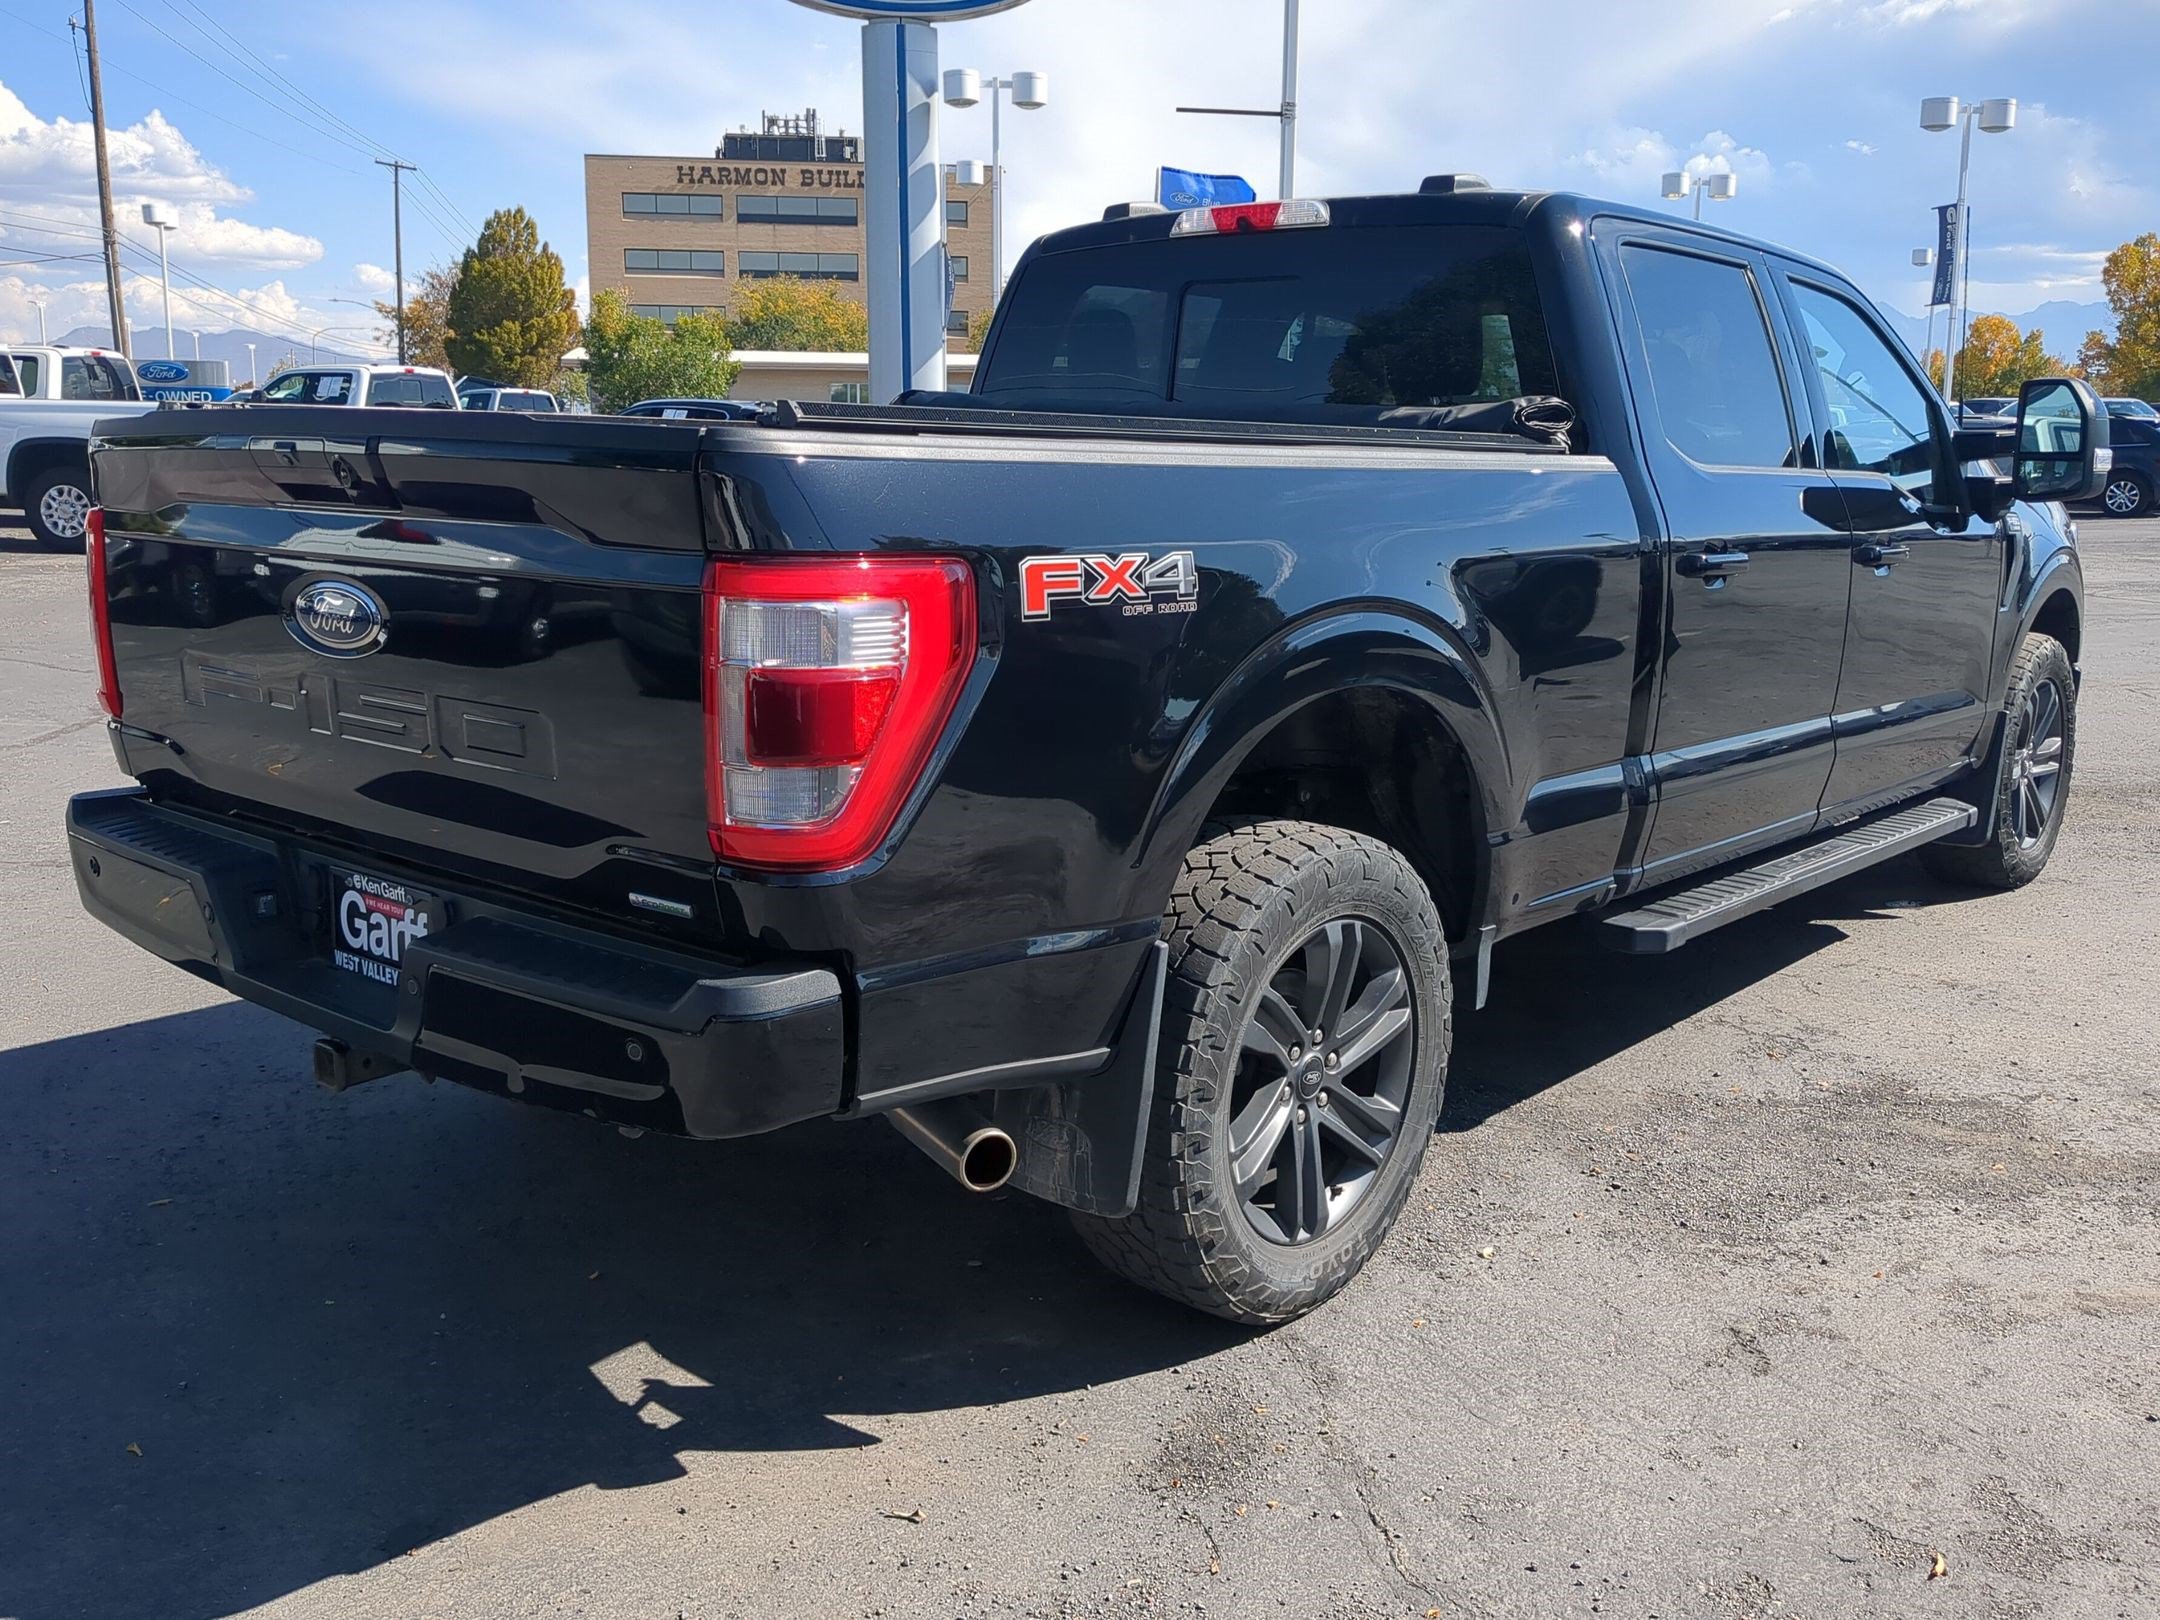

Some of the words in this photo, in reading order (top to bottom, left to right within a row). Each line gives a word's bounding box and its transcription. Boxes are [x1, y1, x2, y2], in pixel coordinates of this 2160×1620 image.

[677, 165, 787, 187] HARMON
[1201, 196, 1221, 207] Blue
[1018, 551, 1199, 623] FX4
[310, 595, 355, 634] Ford
[1123, 605, 1154, 616] OFF
[1158, 602, 1197, 614] ROAD
[180, 649, 559, 782] F-150
[361, 875, 381, 895] Ken
[380, 882, 406, 903] Garff
[334, 949, 360, 972] WEST
[361, 959, 399, 987] VALLEY
